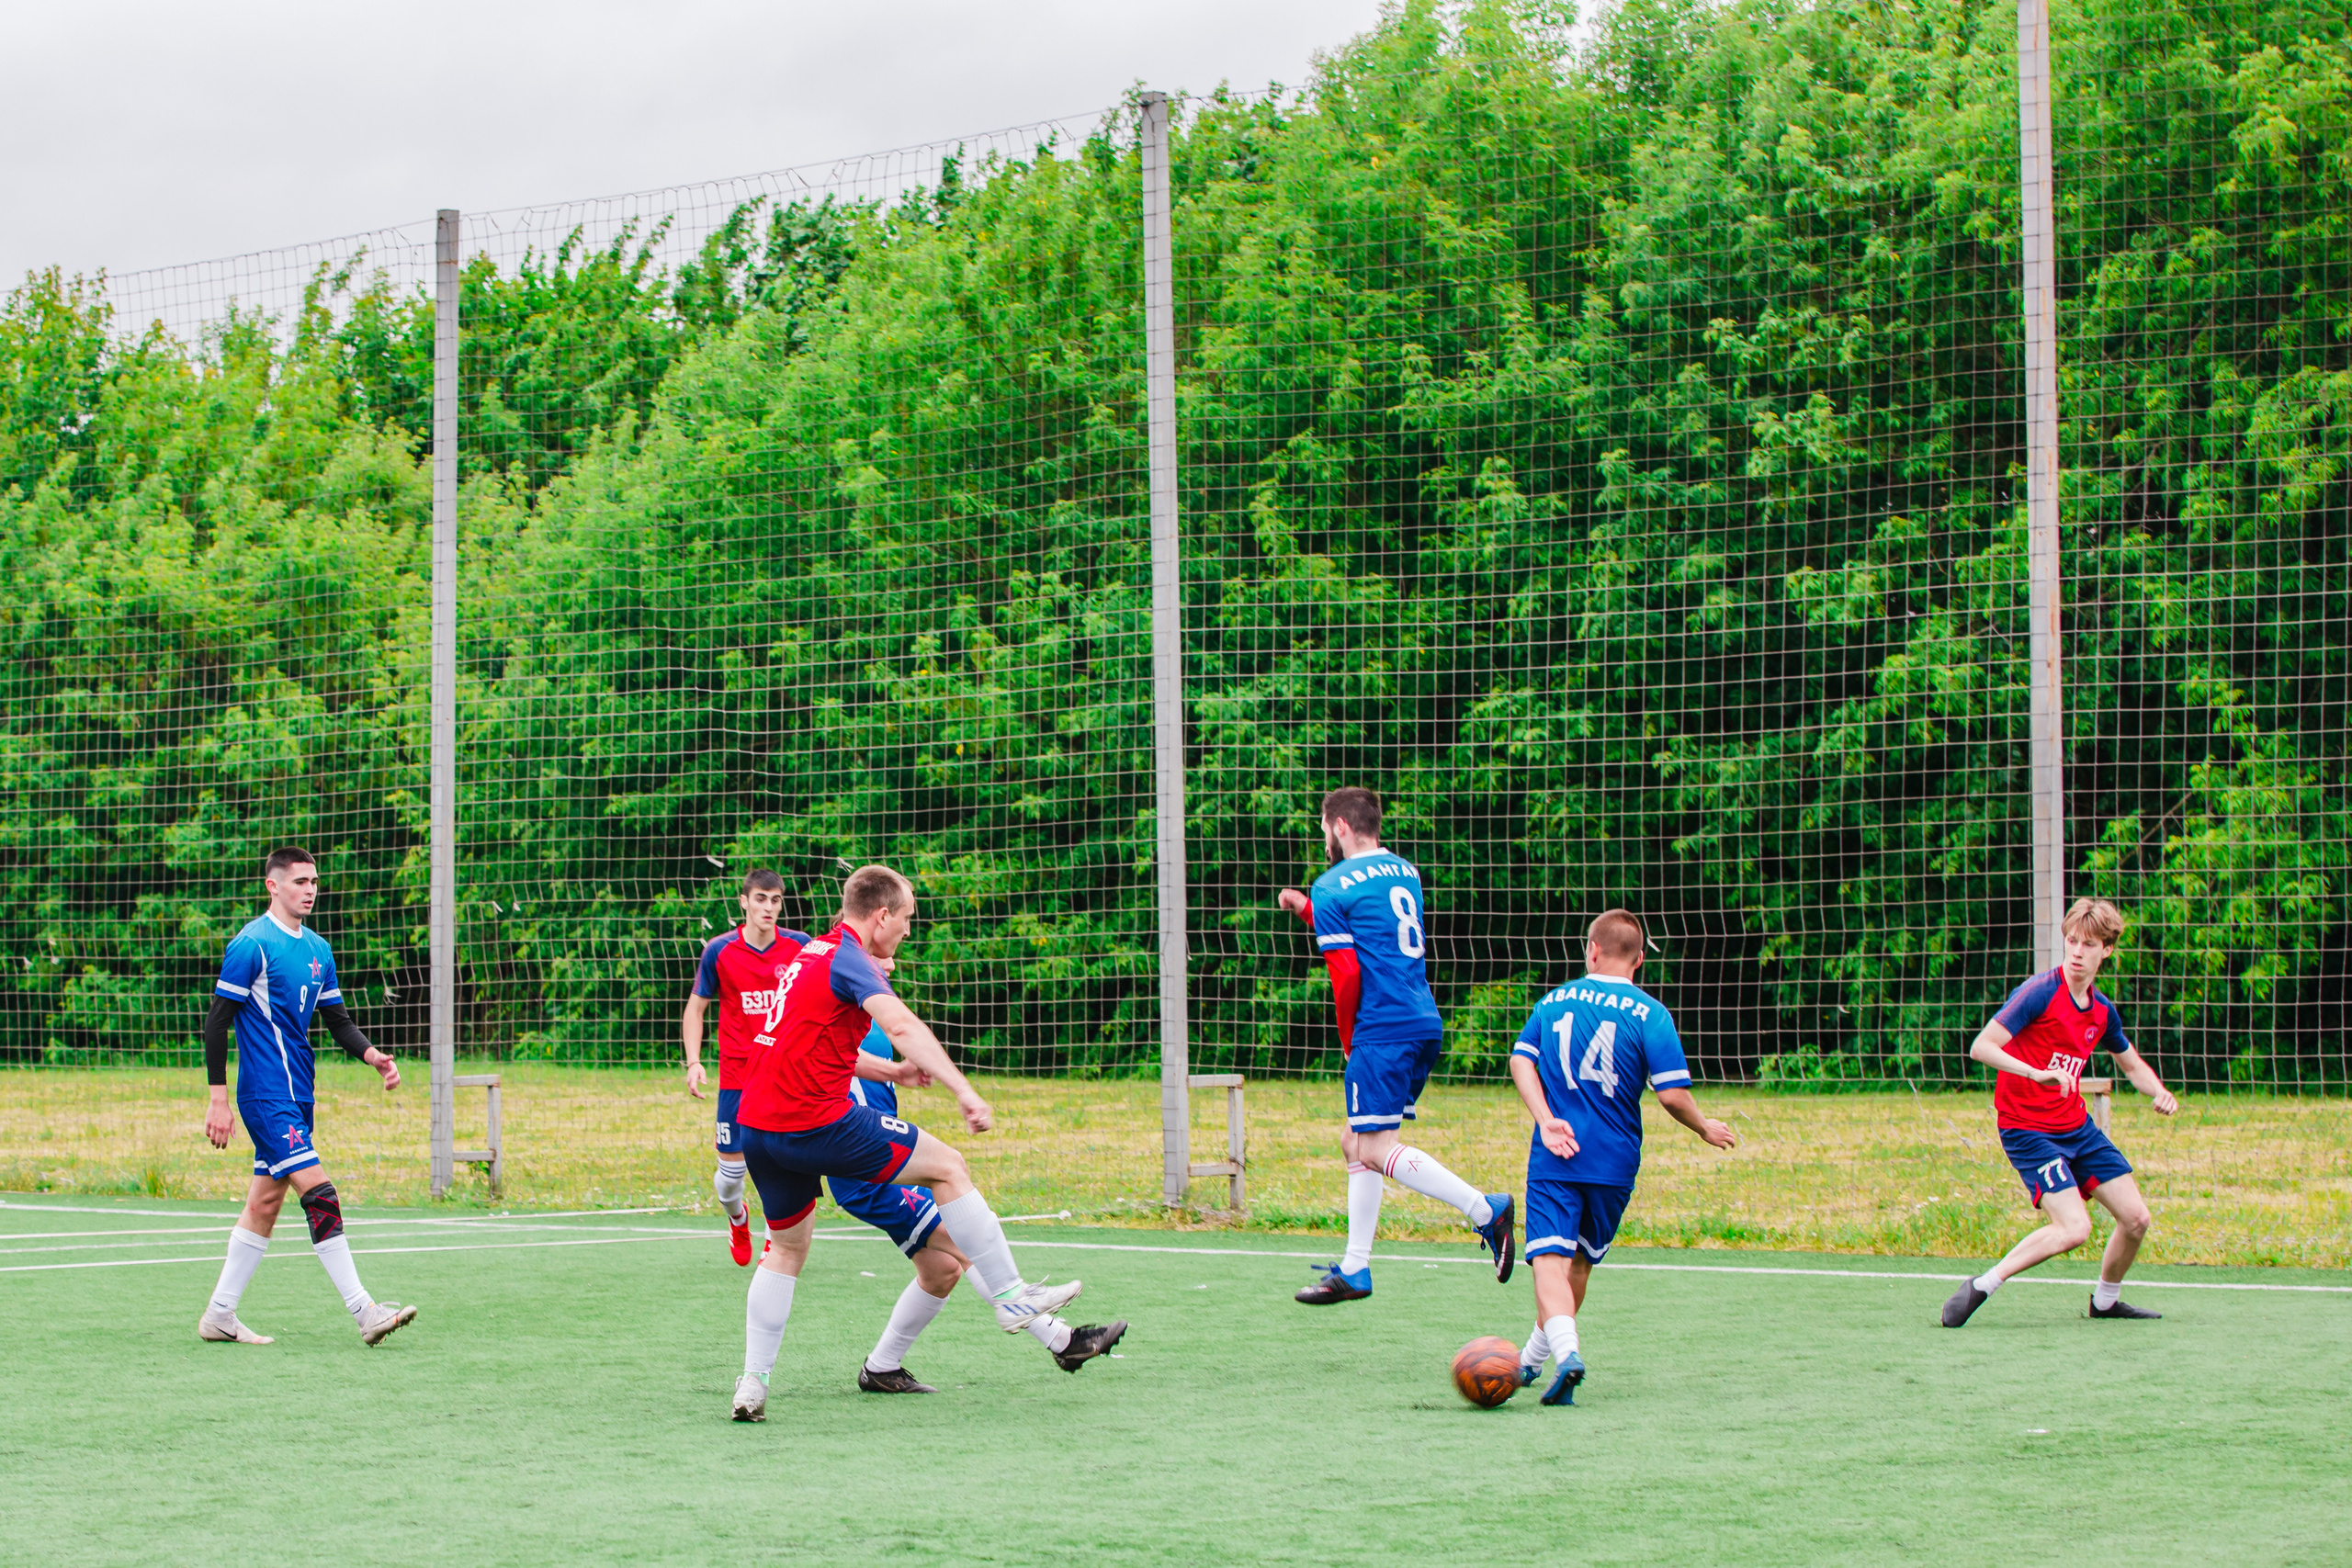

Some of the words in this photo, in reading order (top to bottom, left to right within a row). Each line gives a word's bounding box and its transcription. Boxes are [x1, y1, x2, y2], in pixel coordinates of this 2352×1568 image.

[1389, 886, 1425, 959] 8
[300, 985, 308, 1013] 9
[1542, 987, 1650, 1021] АВАНГАРД
[1553, 1011, 1619, 1098] 14
[881, 1115, 909, 1134] 8
[2037, 1157, 2067, 1189] 77
